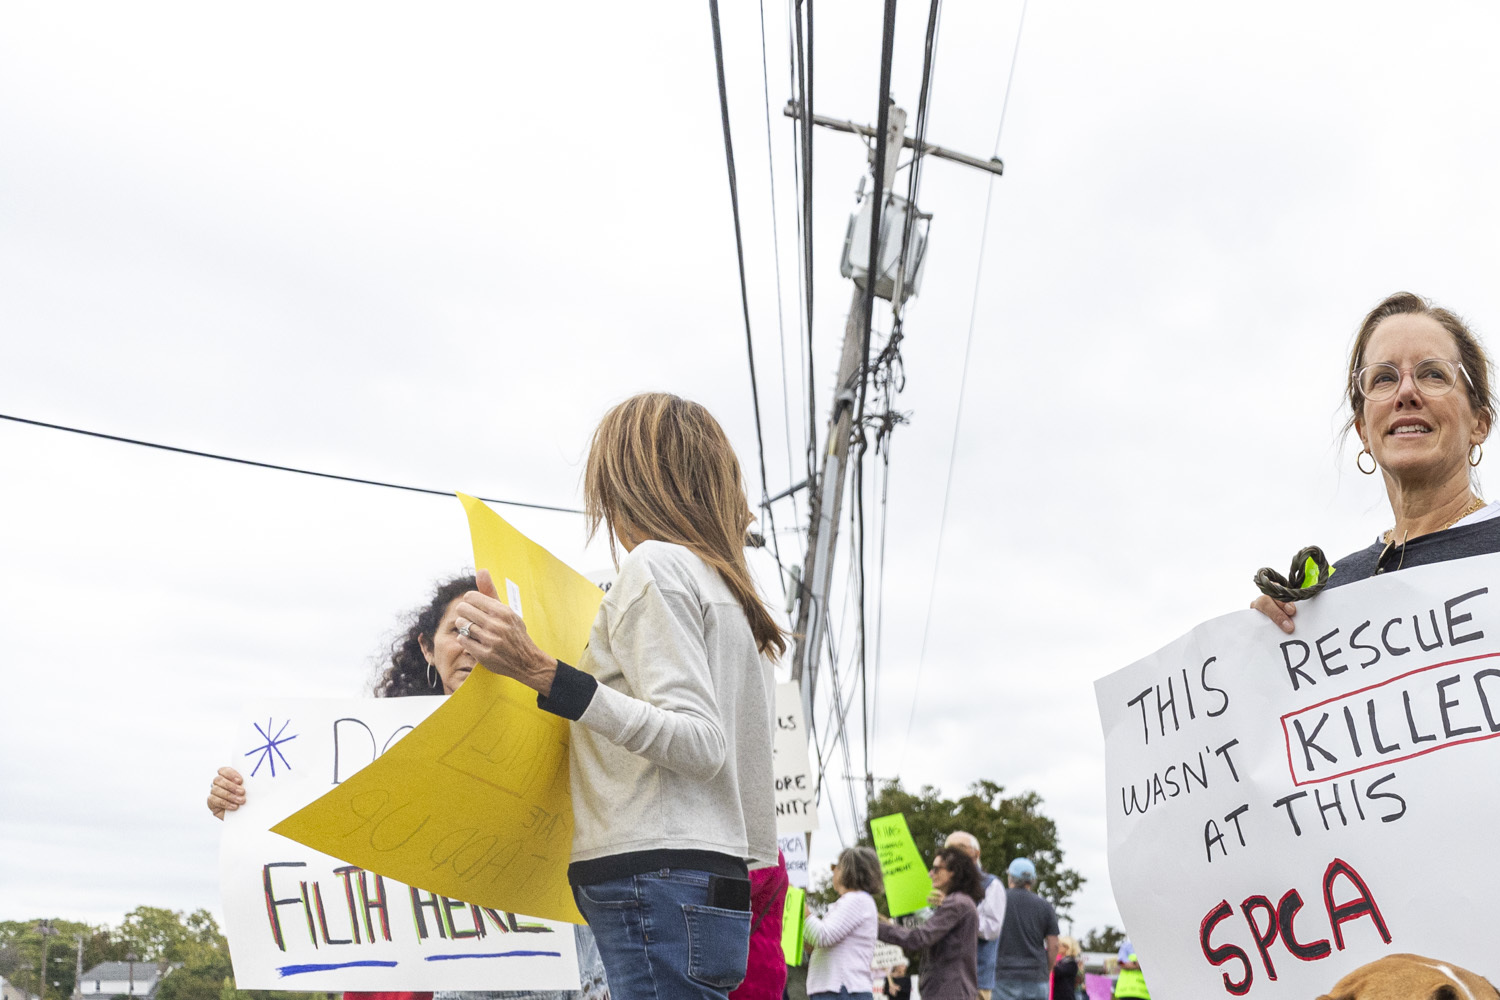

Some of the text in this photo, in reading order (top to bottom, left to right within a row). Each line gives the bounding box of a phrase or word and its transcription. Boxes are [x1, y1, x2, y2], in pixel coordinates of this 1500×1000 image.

[1127, 587, 1489, 745] THIS RESCUE
[1121, 739, 1240, 816] WASN'T
[1204, 773, 1408, 863] AT THIS
[263, 862, 392, 951] FILTH
[1200, 858, 1392, 996] SPCA
